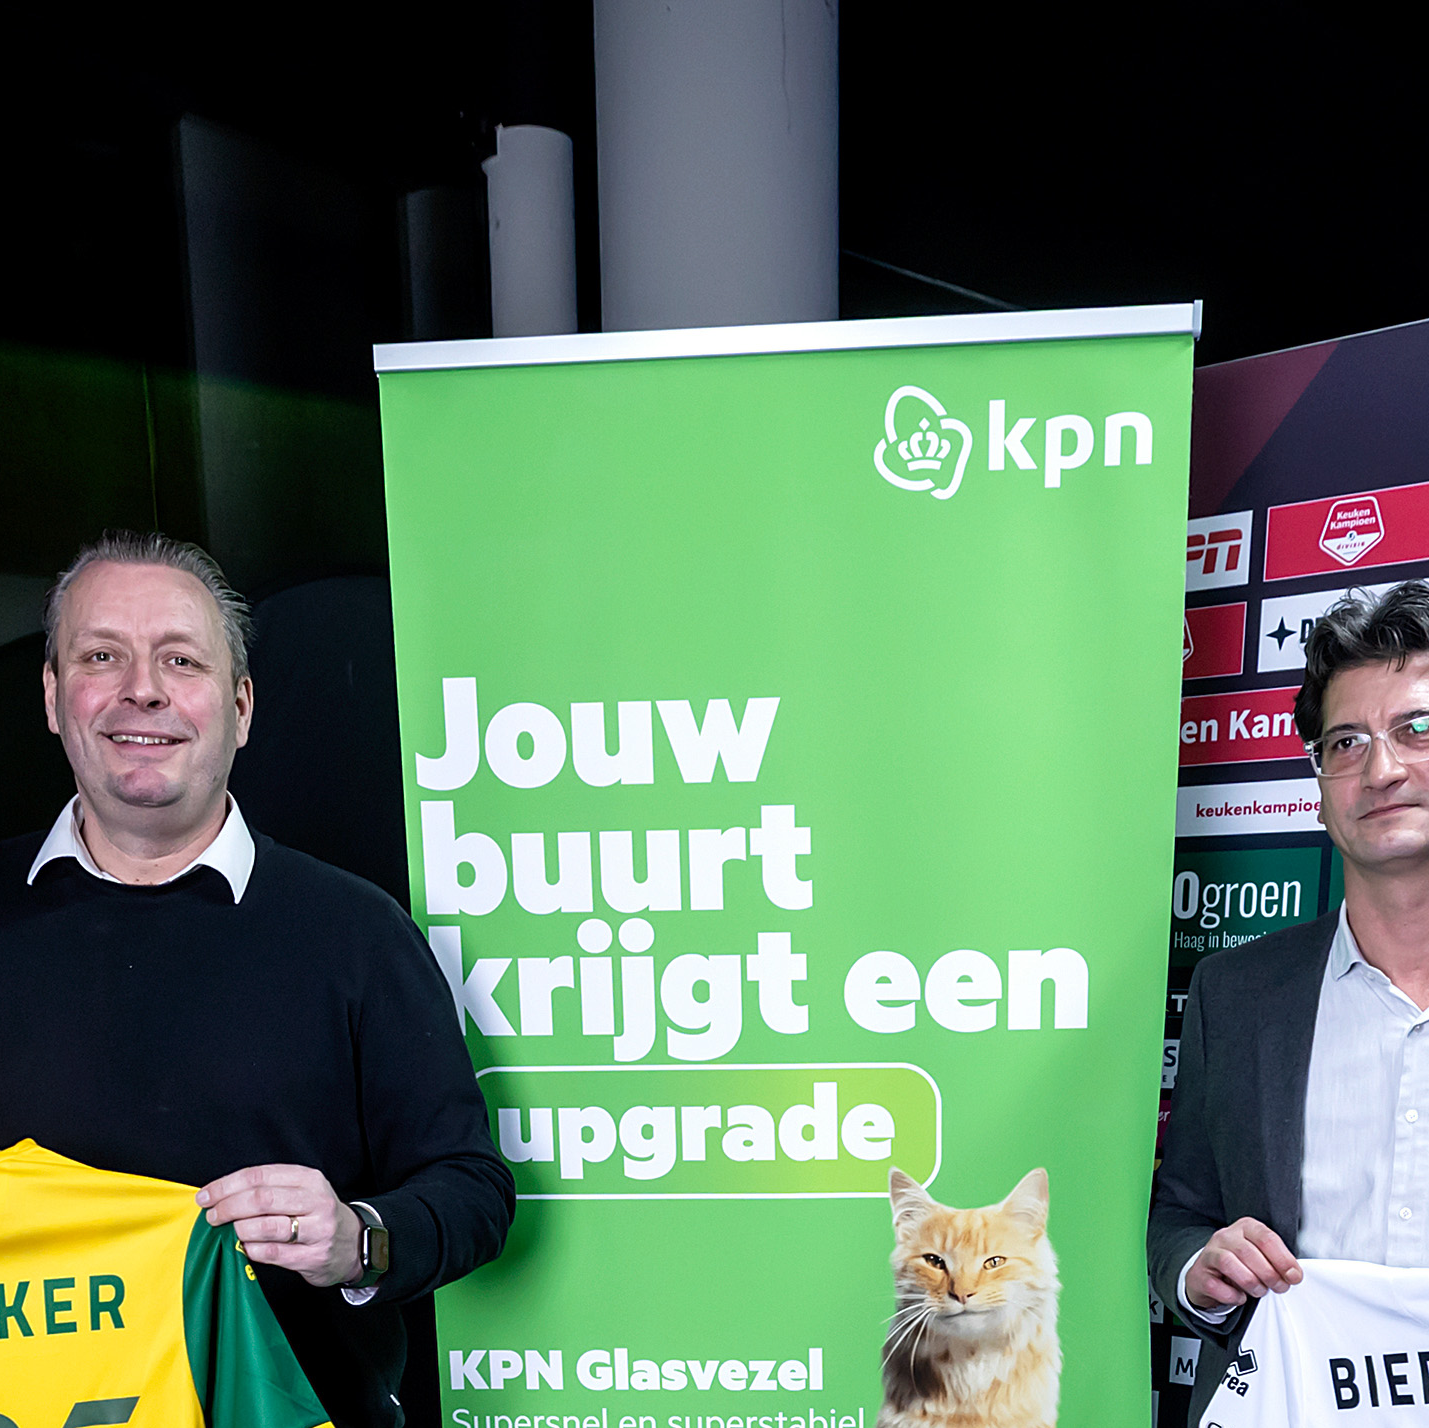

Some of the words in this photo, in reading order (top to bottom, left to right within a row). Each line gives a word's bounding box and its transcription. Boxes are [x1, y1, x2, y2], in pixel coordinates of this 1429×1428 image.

[988, 399, 1154, 489] kpn
[1329, 515, 1376, 531] Kampioen
[1336, 507, 1371, 521] Keuken
[415, 676, 781, 791] Jouw
[419, 799, 814, 916] buurt
[1174, 931, 1206, 952] Haag
[1209, 931, 1220, 949] in
[427, 918, 810, 1062] krijgt
[843, 945, 1089, 1034] een
[498, 1080, 896, 1181] upgrade
[449, 1348, 564, 1391] KPN
[576, 1346, 824, 1392] Glasvezel
